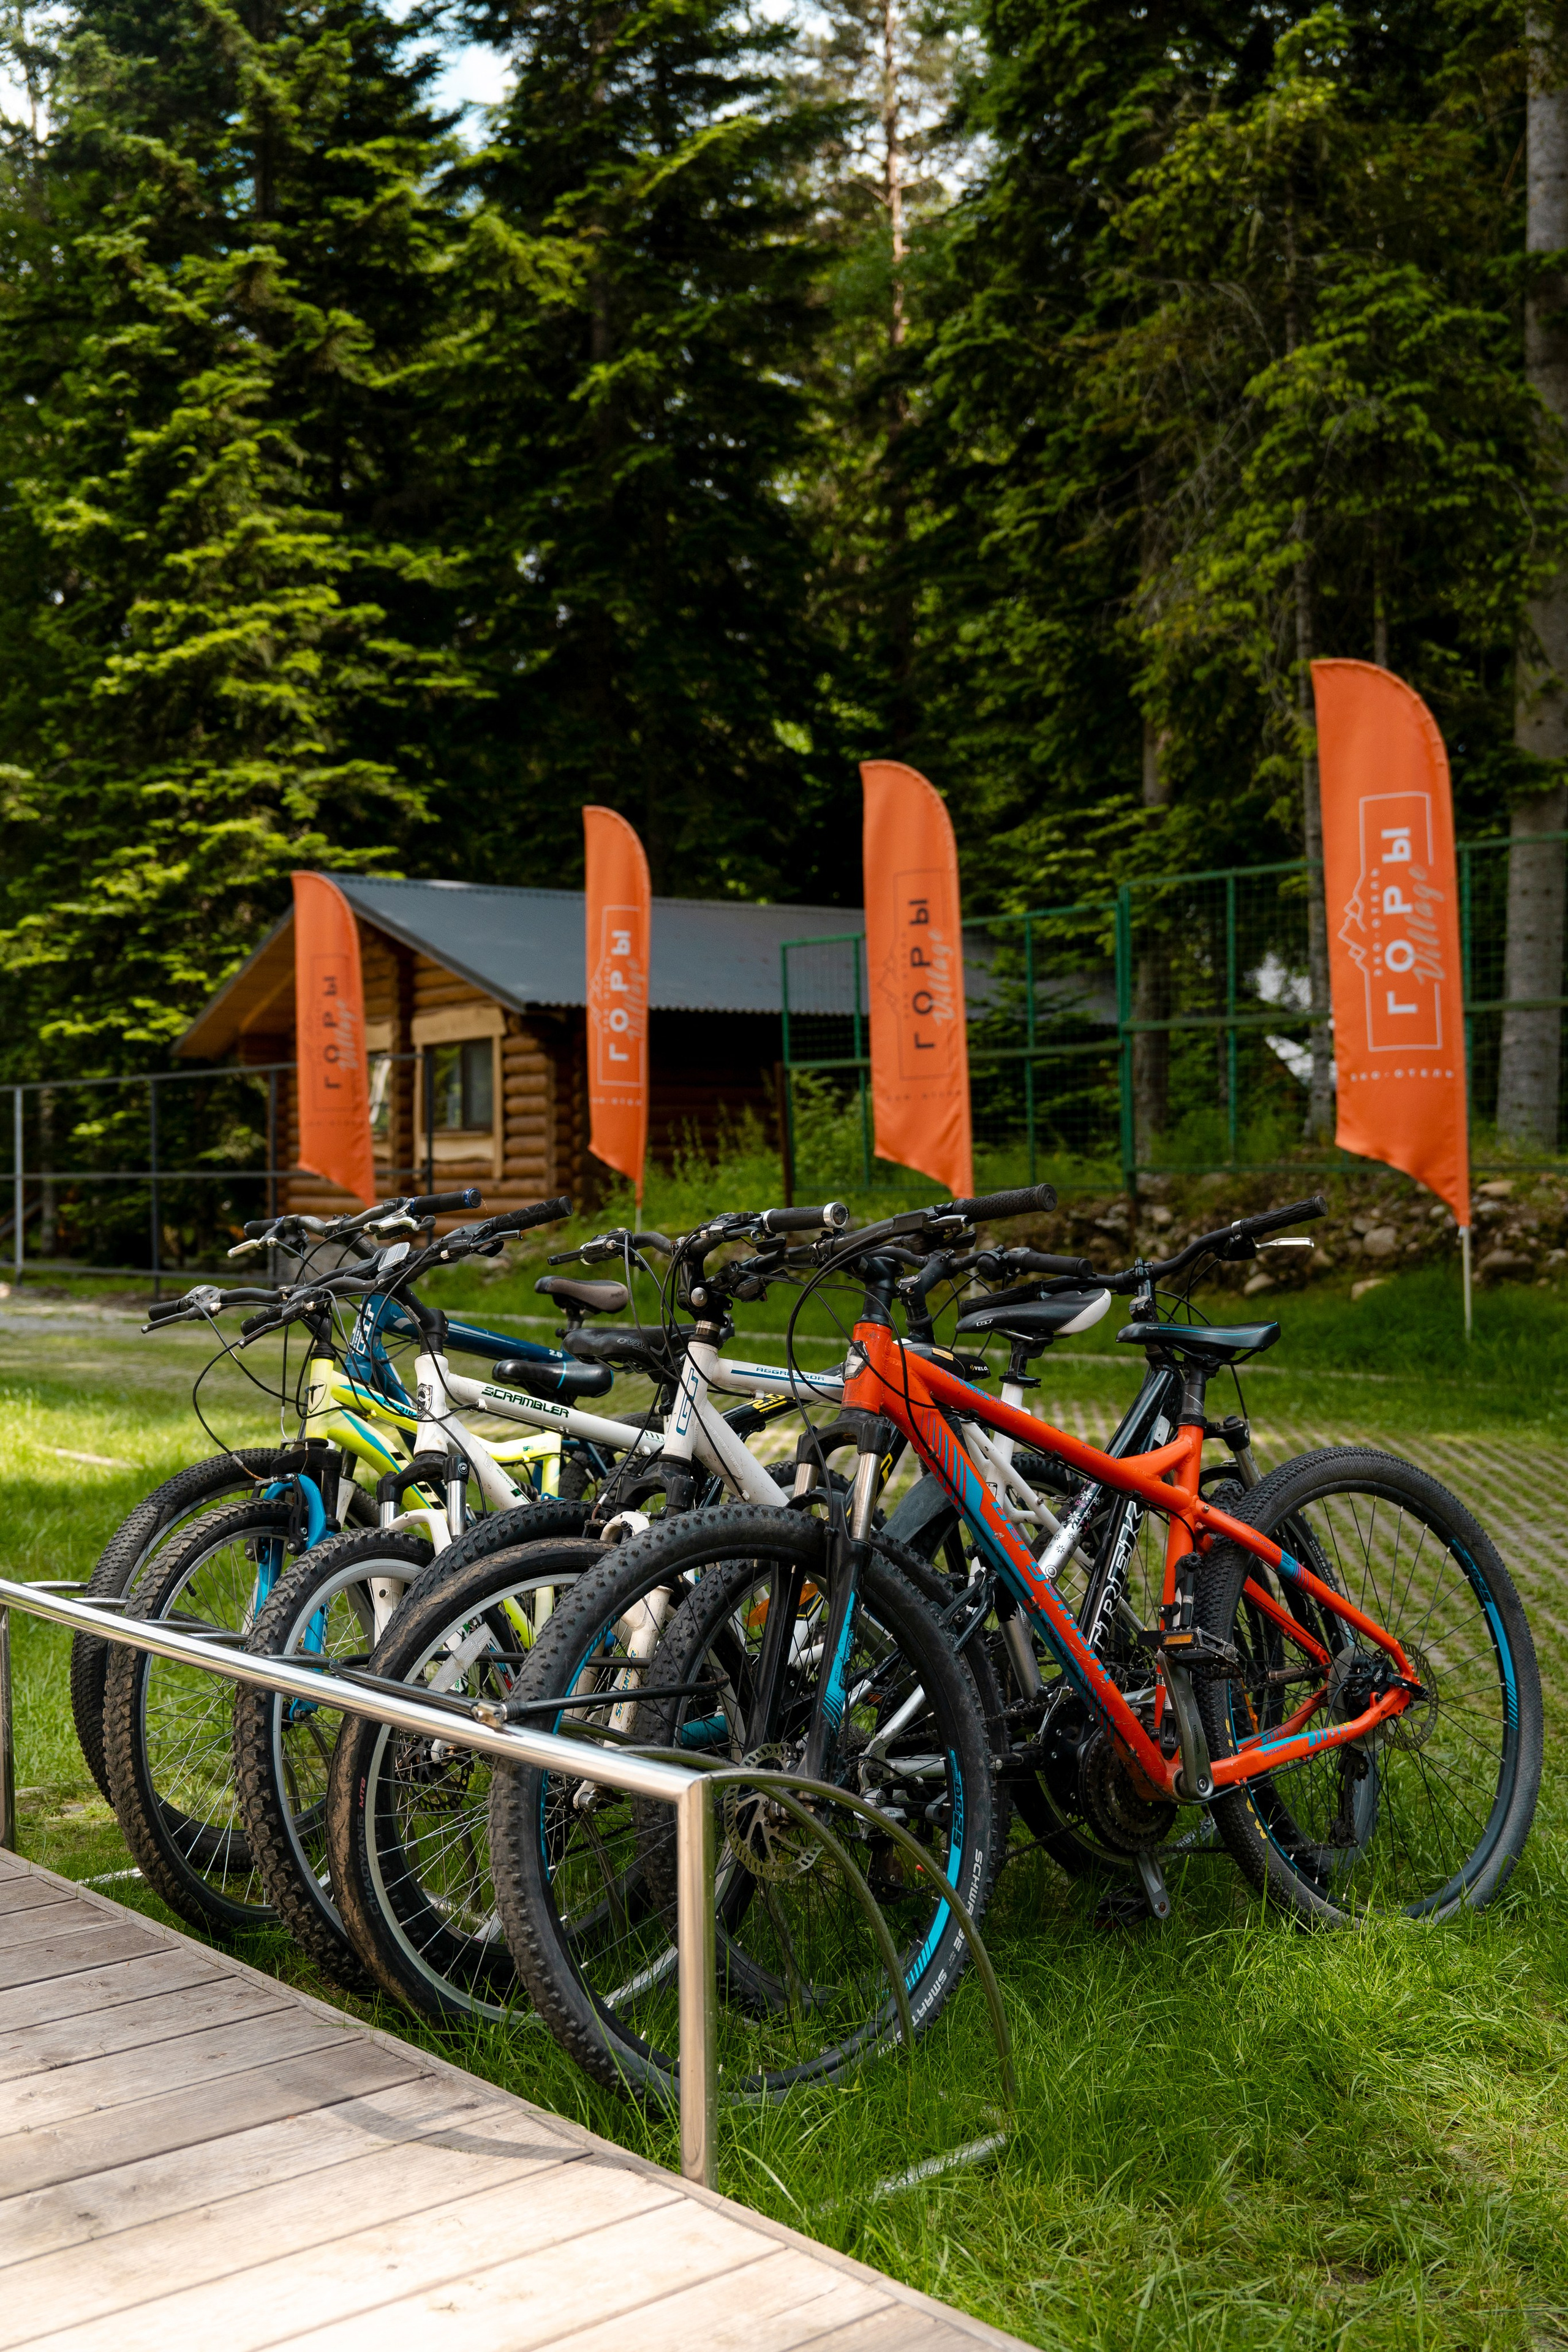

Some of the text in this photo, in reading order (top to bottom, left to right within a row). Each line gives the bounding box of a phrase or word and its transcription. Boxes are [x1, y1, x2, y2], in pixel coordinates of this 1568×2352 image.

[1381, 827, 1418, 1015] ГОРЫ
[1404, 864, 1446, 986] Village
[609, 930, 631, 1061] ГОРЫ
[908, 899, 936, 1050] ГОРЫ
[925, 927, 954, 1027] Village
[323, 976, 341, 1090] ГОРЫ
[481, 1385, 570, 1419] SCRAMBLER
[548, 1348, 563, 1359] 2.0
[676, 1366, 699, 1436] GT
[357, 1813, 380, 1915] CHAOYANG
[953, 1849, 983, 1953] SCHWABE
[911, 1968, 948, 2027] SMART
